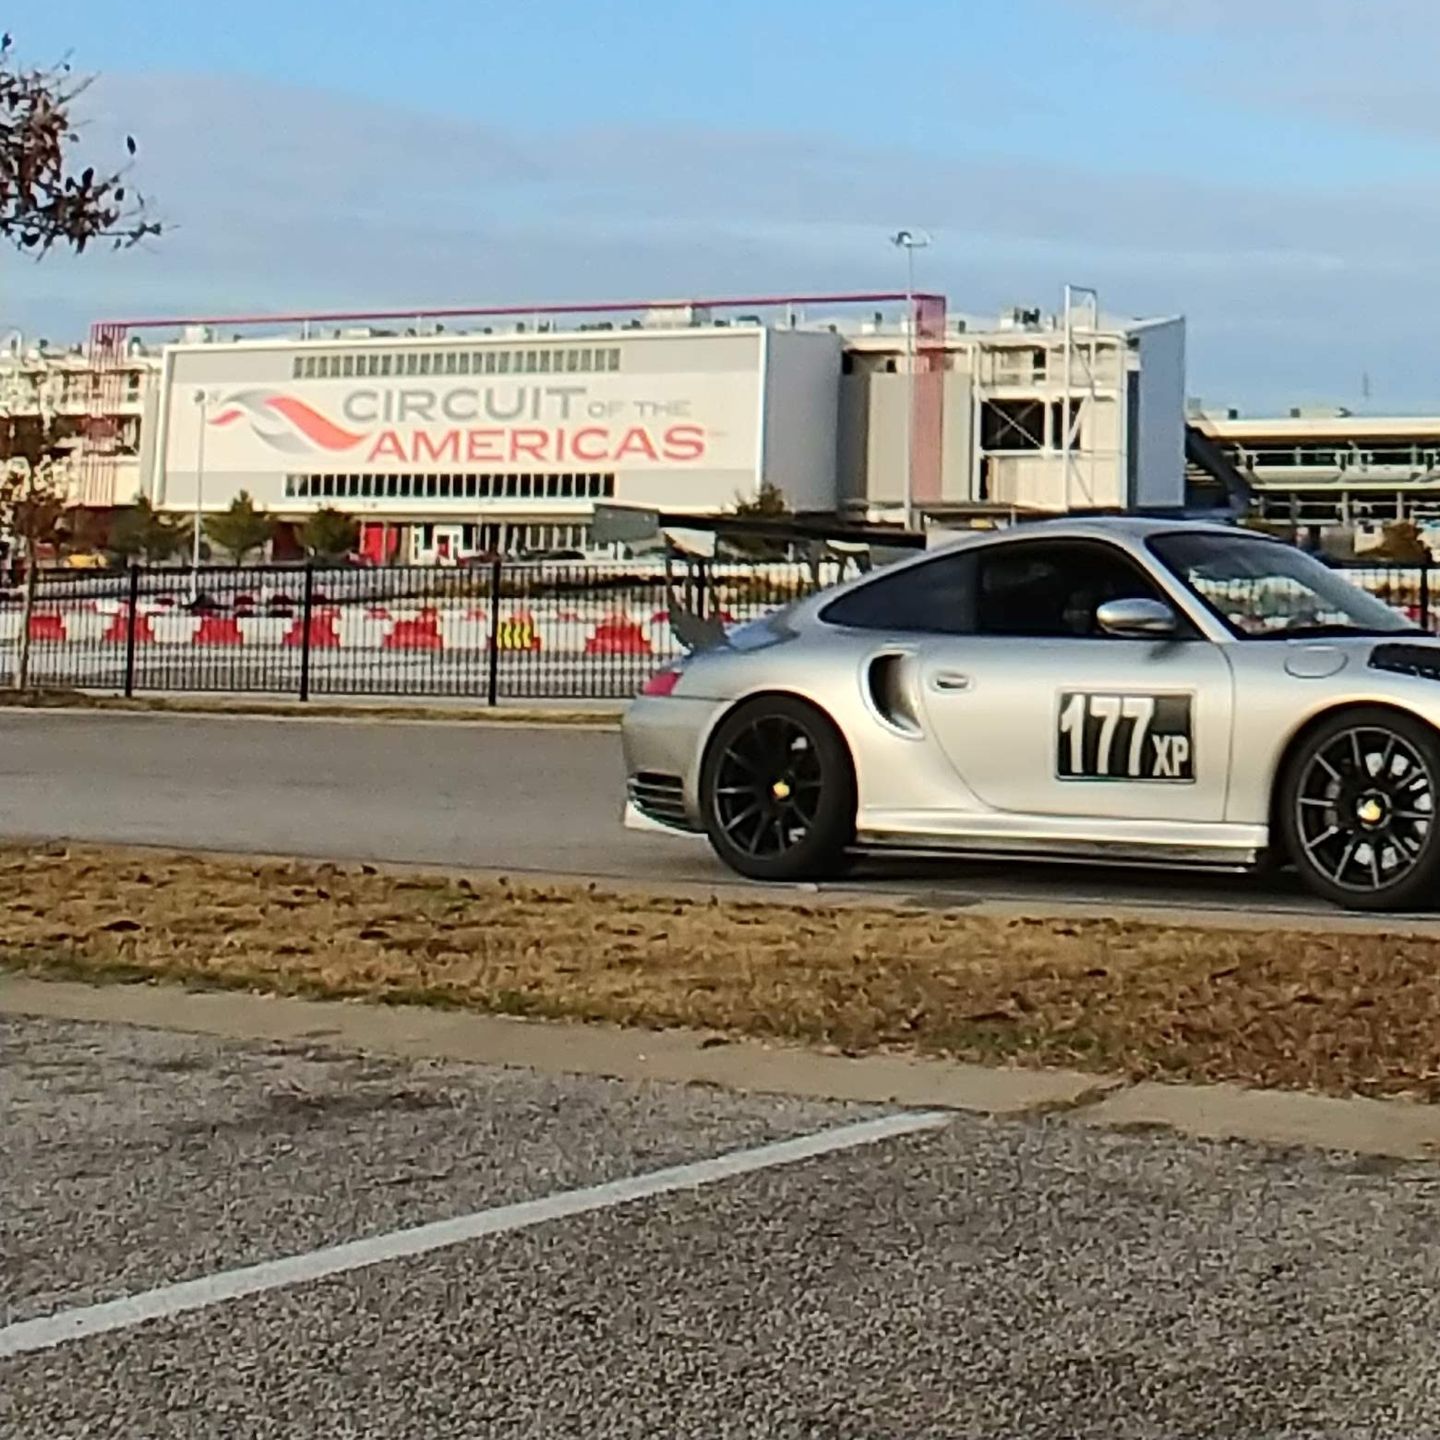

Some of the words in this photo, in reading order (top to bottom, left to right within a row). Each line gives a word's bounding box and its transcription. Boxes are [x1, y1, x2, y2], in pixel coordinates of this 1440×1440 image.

[343, 386, 587, 423] CIRCUIT
[587, 400, 624, 419] OF
[632, 399, 691, 418] THE
[365, 425, 706, 464] AMERICAS
[1060, 693, 1155, 777] 177
[1152, 734, 1190, 777] XP
